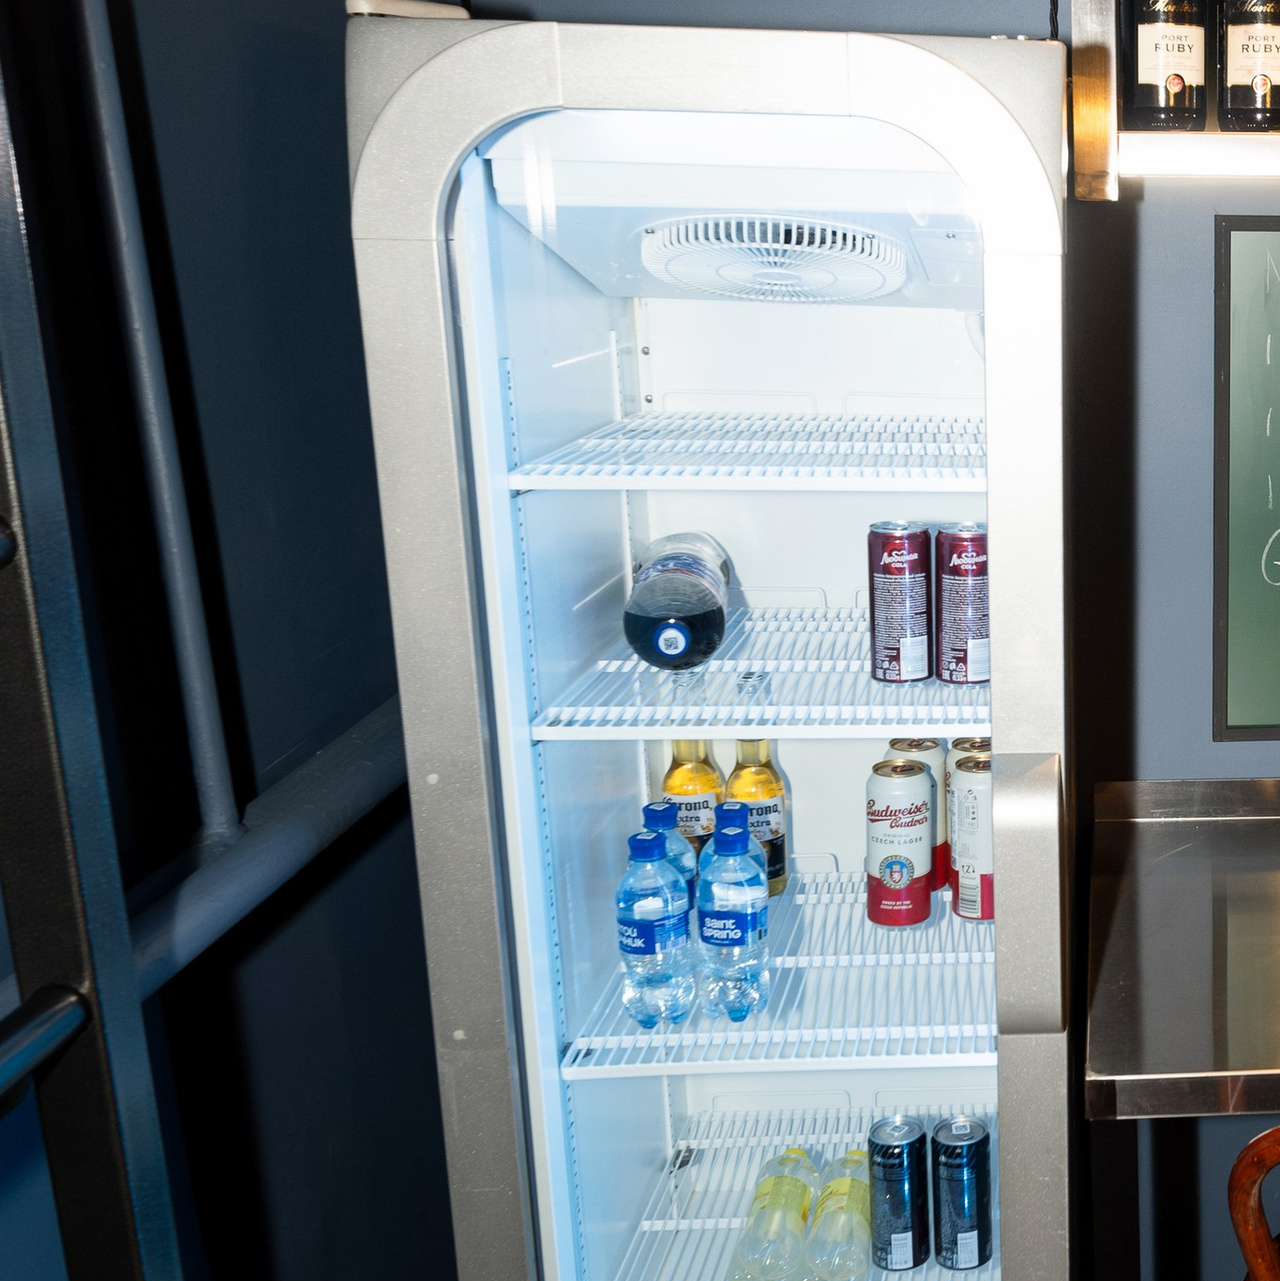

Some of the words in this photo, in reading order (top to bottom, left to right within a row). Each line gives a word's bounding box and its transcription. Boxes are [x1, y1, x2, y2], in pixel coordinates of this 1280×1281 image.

[867, 798, 930, 818] Budweiser
[678, 815, 701, 823] xtra
[749, 819, 771, 828] xtra
[889, 815, 928, 829] Budvar
[871, 836, 895, 845] CZECH
[897, 836, 923, 845] LAGER
